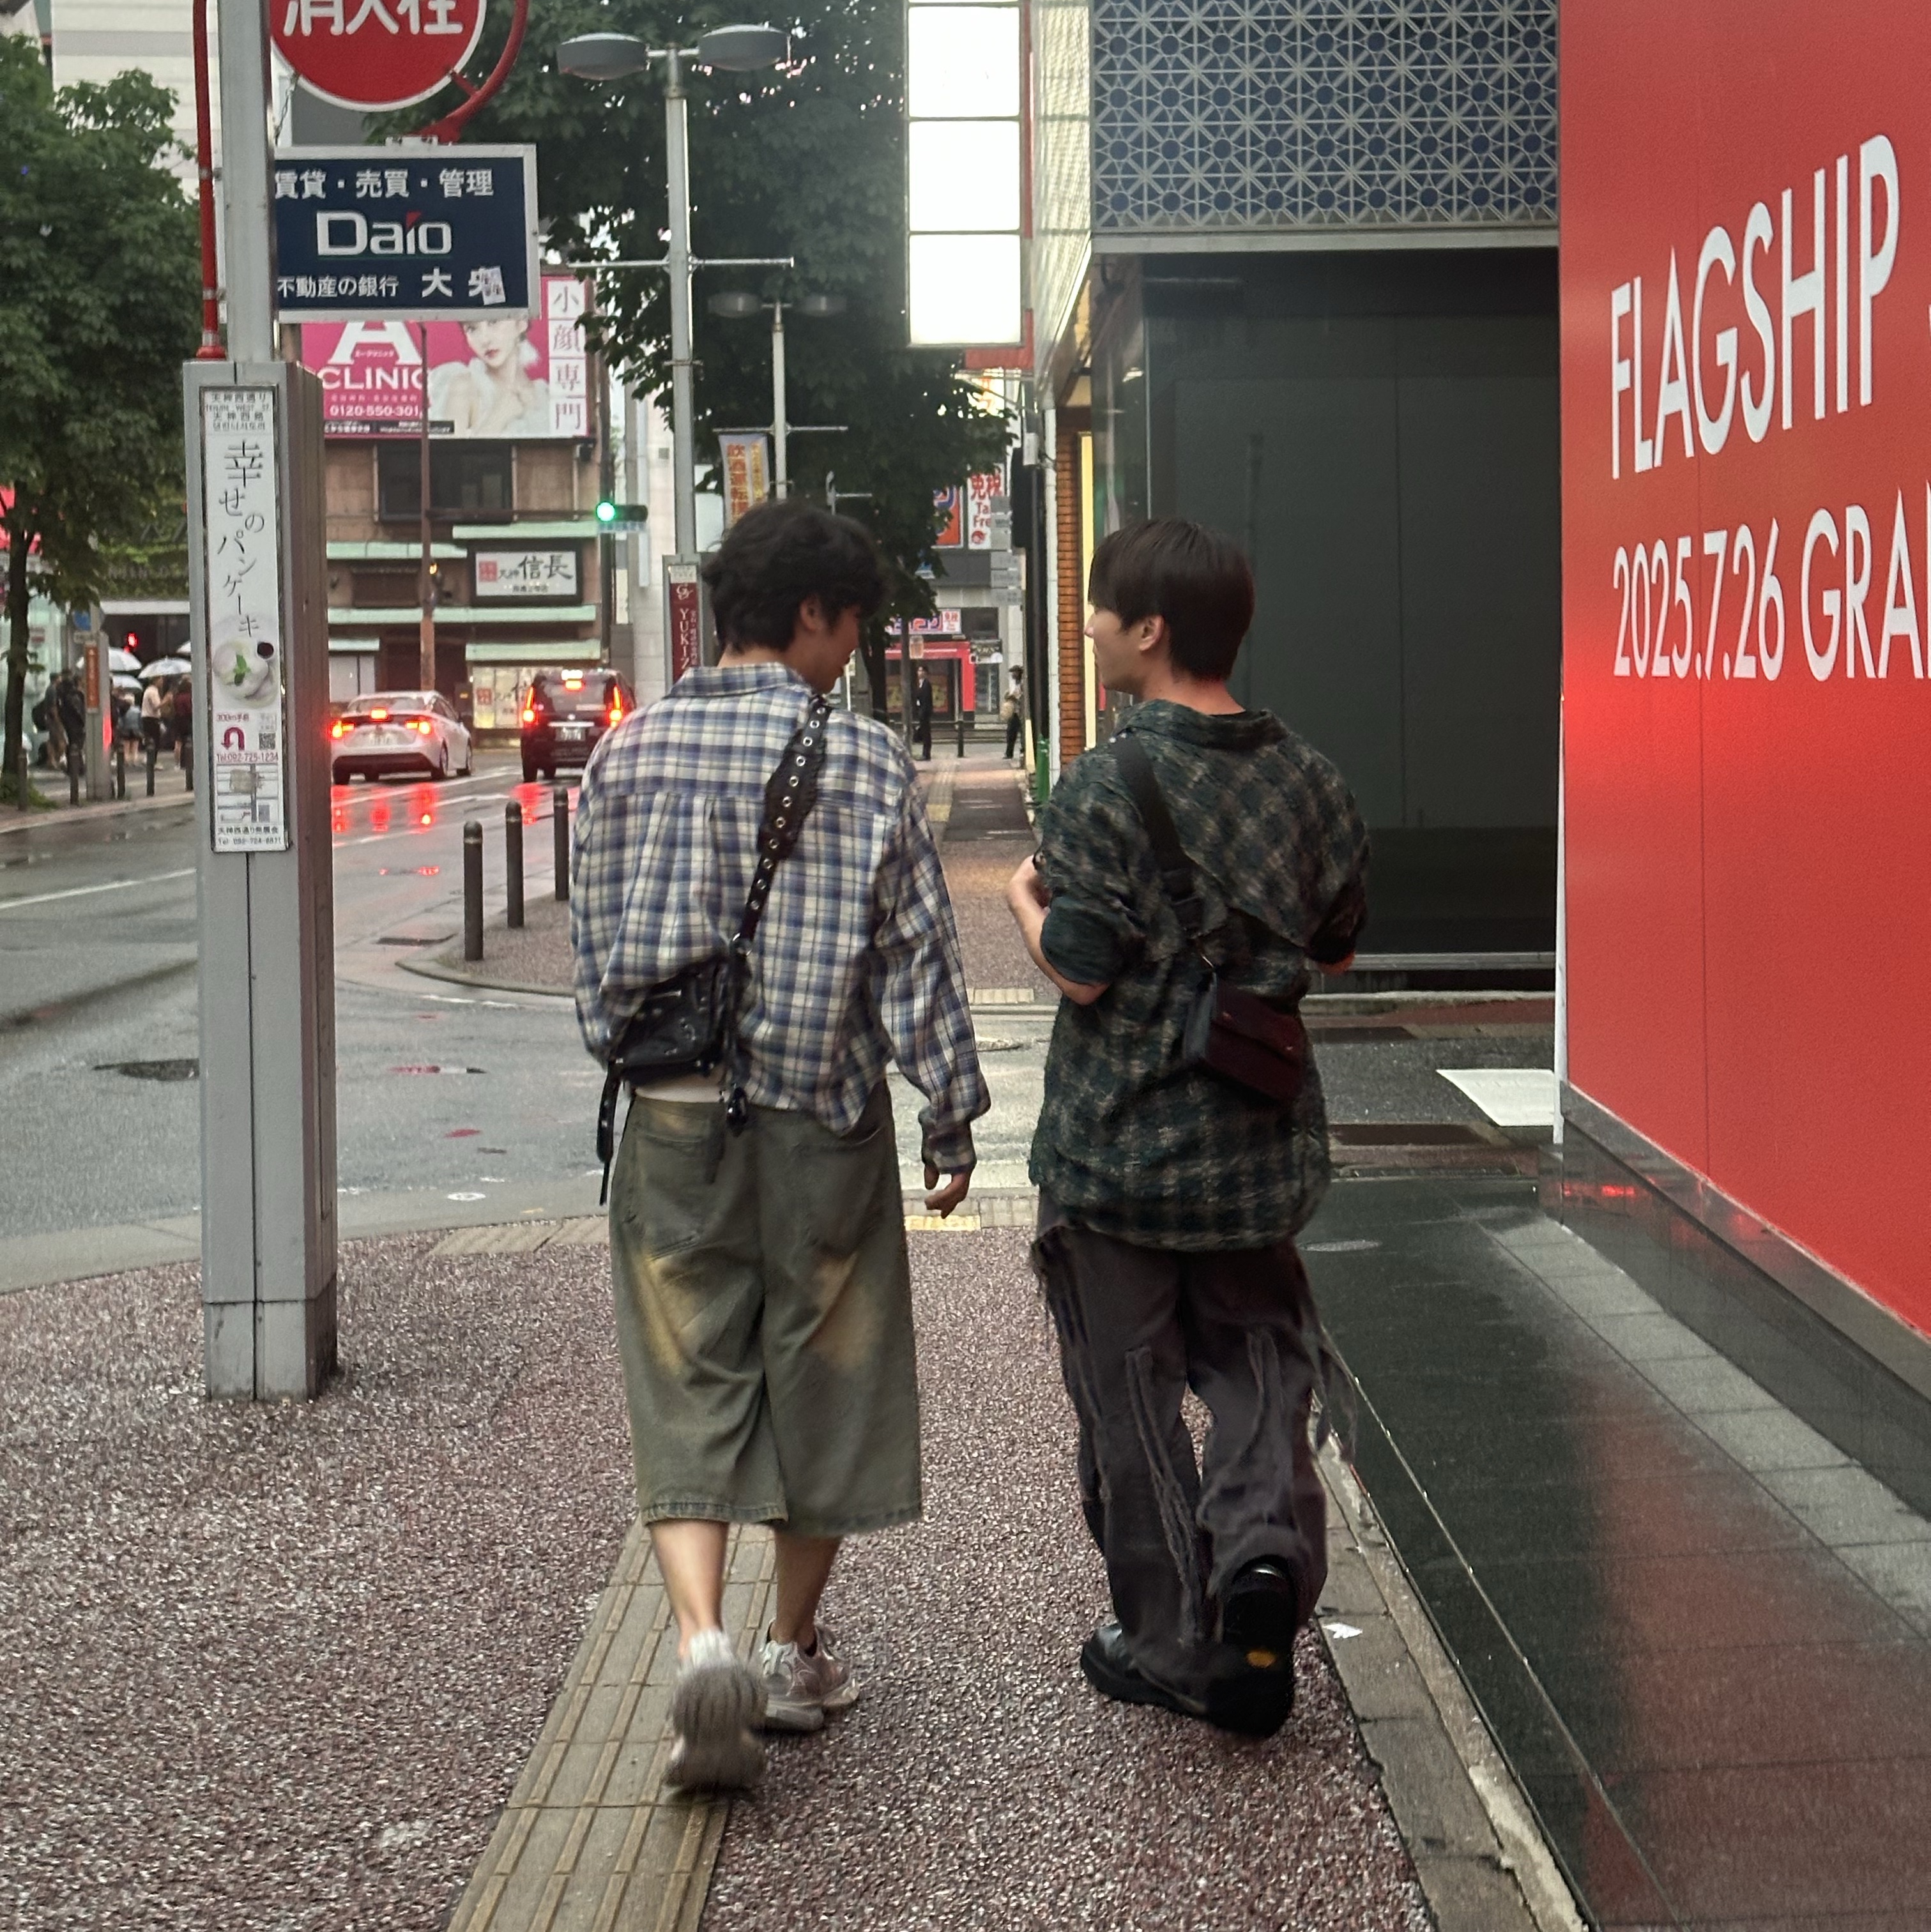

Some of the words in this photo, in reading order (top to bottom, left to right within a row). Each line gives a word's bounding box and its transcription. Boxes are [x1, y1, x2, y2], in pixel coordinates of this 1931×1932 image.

[277, 275, 399, 299] 不動産の銀行
[316, 209, 452, 255] Daio
[327, 321, 422, 365] A
[1610, 134, 1900, 480] FLAGSHIP
[215, 439, 264, 637] 幸せのパンケーキ
[1613, 517, 1785, 681] 2025.7.26
[1800, 480, 1931, 682] GRA
